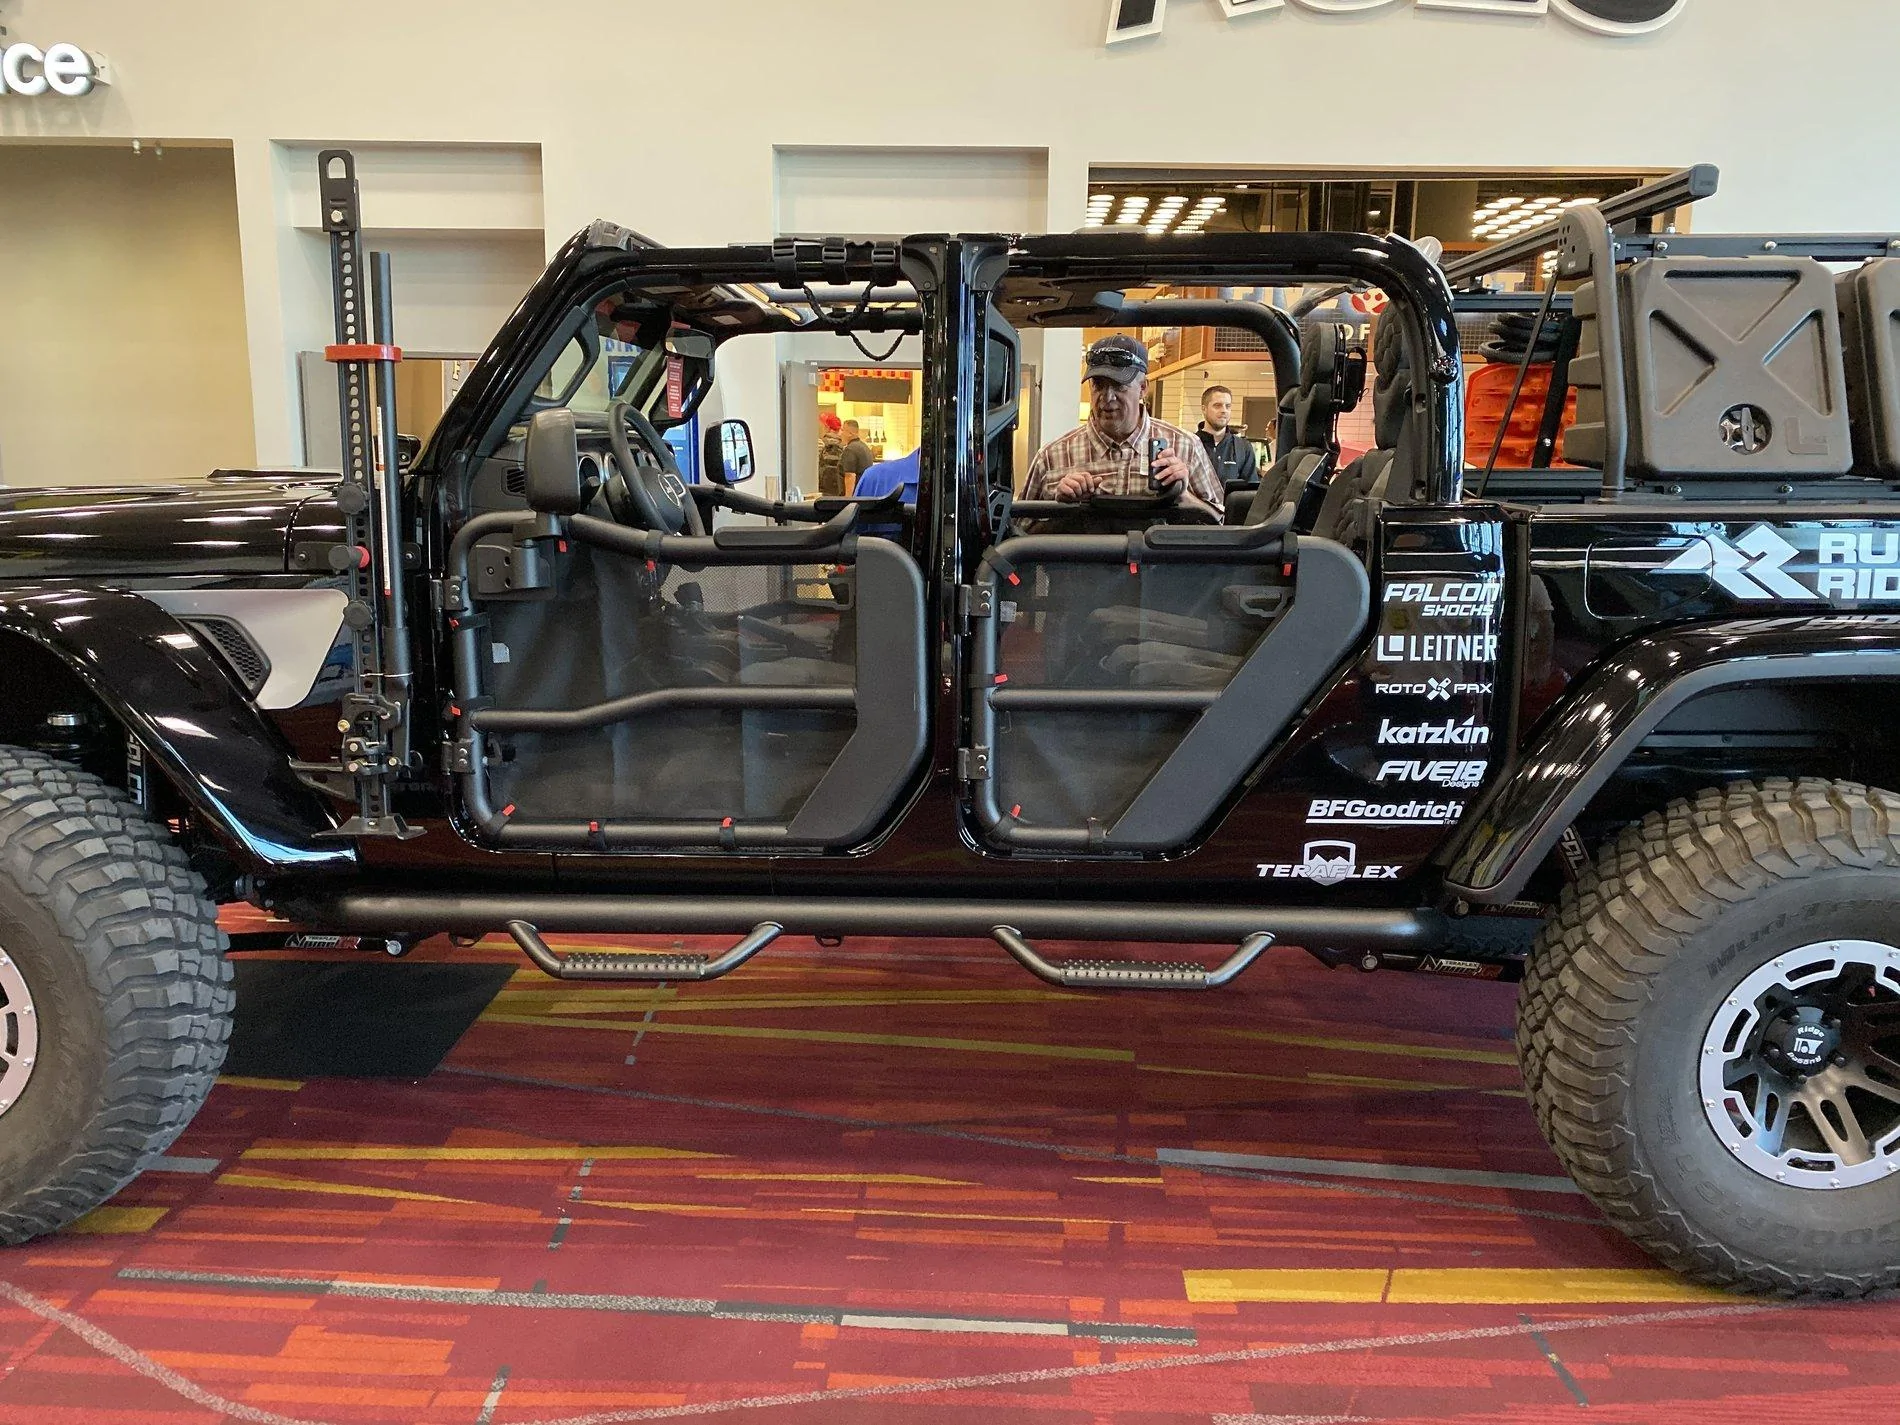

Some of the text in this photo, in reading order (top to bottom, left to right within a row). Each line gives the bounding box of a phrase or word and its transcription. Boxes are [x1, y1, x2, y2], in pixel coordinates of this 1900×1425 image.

[0, 42, 94, 96] ce
[1383, 583, 1501, 602] FALCON
[1409, 634, 1498, 662] LEITNER
[1375, 683, 1427, 694] ROTO
[1453, 683, 1493, 694] PAX
[1377, 714, 1490, 744] katzkin
[1441, 779, 1480, 789] Designs
[1307, 799, 1464, 818] BFGoodrich
[1256, 863, 1403, 879] TERAFLEX
[1797, 1025, 1825, 1038] Ridge
